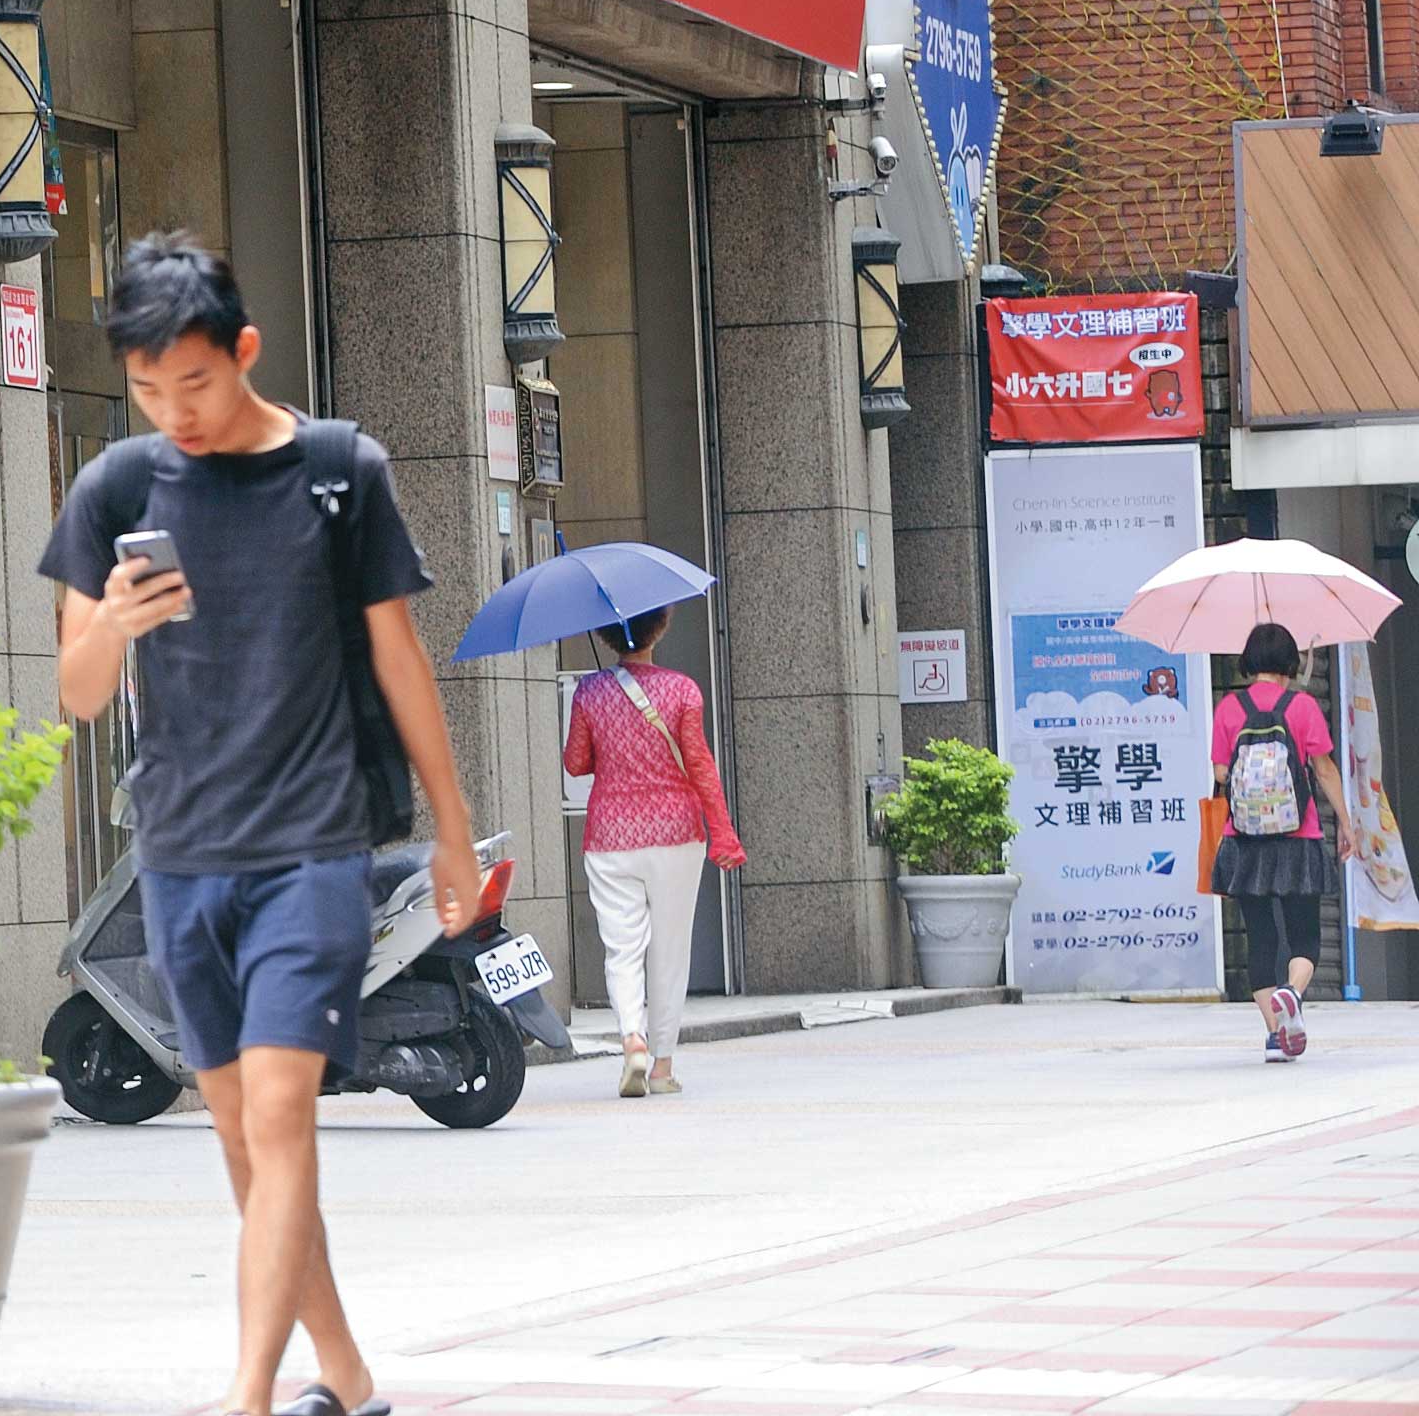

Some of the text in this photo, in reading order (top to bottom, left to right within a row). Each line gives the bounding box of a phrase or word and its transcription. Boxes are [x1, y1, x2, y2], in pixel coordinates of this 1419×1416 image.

[925, 15, 983, 84] 2796-5759
[1001, 304, 1187, 340] 擎學文理補習班
[9, 325, 35, 372] 161
[1005, 370, 1133, 399] 小六升國七
[1053, 743, 1163, 793] 擎學
[1034, 797, 1187, 827] 文理補習班
[1061, 862, 1142, 882] StudyBank
[1062, 903, 1198, 923] 02-2792-6615
[1064, 930, 1199, 951] 02-2796-5759
[485, 950, 549, 994] 599-JZR
